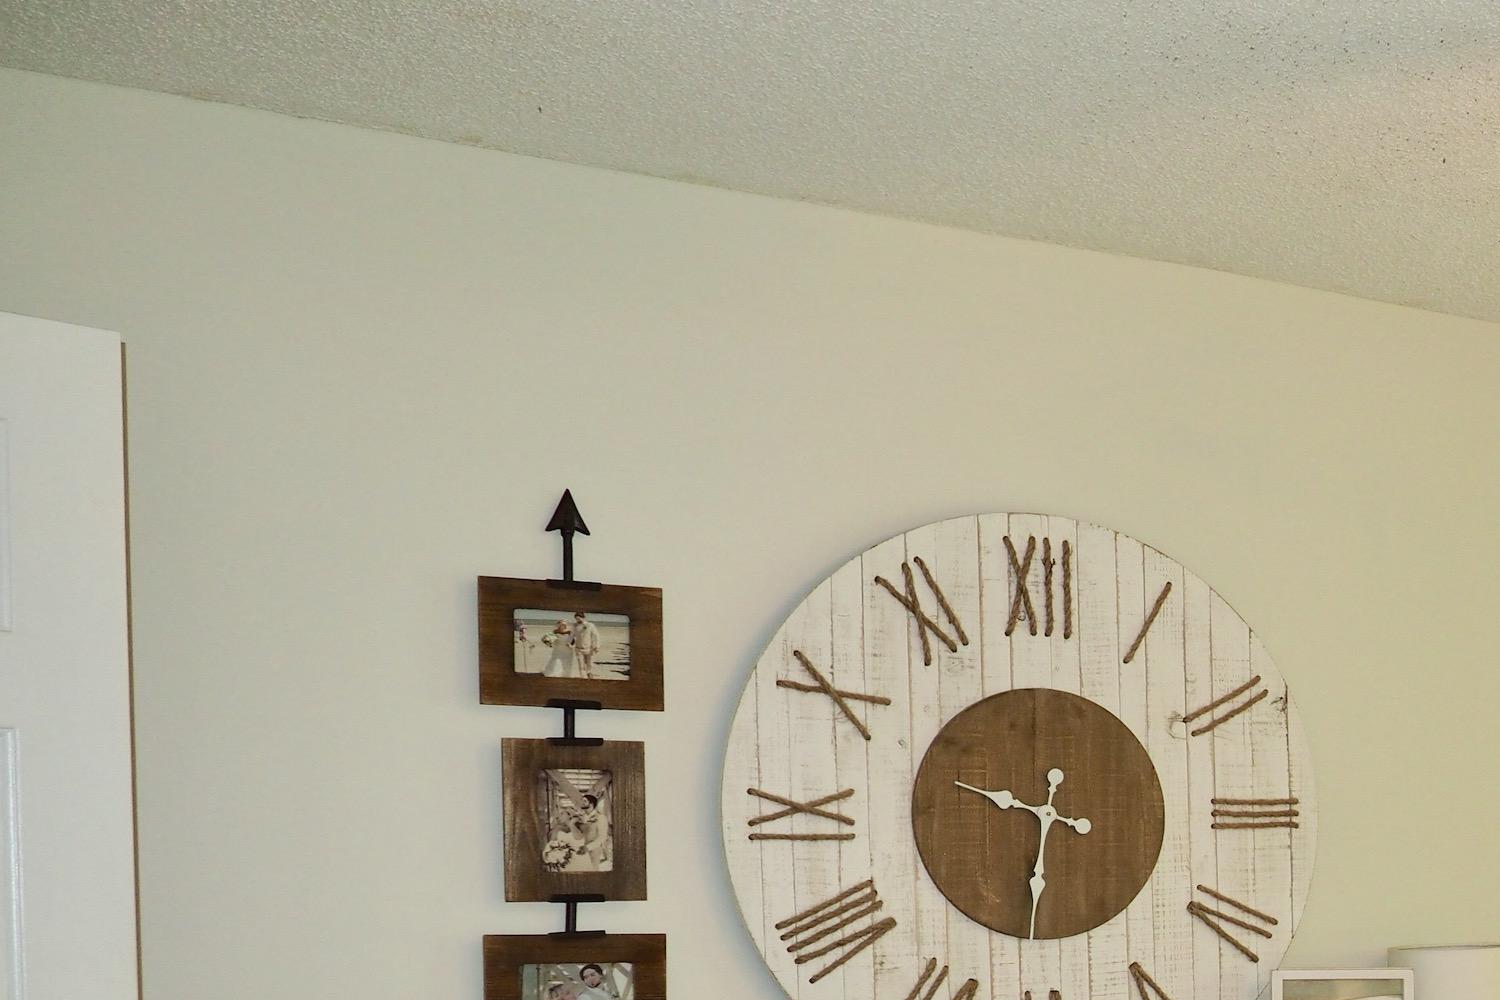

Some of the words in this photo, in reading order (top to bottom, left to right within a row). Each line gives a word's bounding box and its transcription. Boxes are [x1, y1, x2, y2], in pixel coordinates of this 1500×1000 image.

[874, 556, 969, 666] XI
[1003, 535, 1073, 639] XII
[1123, 582, 1172, 664] I
[776, 650, 891, 741] X
[1182, 676, 1269, 736] II
[747, 787, 855, 841] IX
[1210, 797, 1300, 829] III
[775, 879, 897, 984] VIII
[1188, 884, 1279, 962] IV
